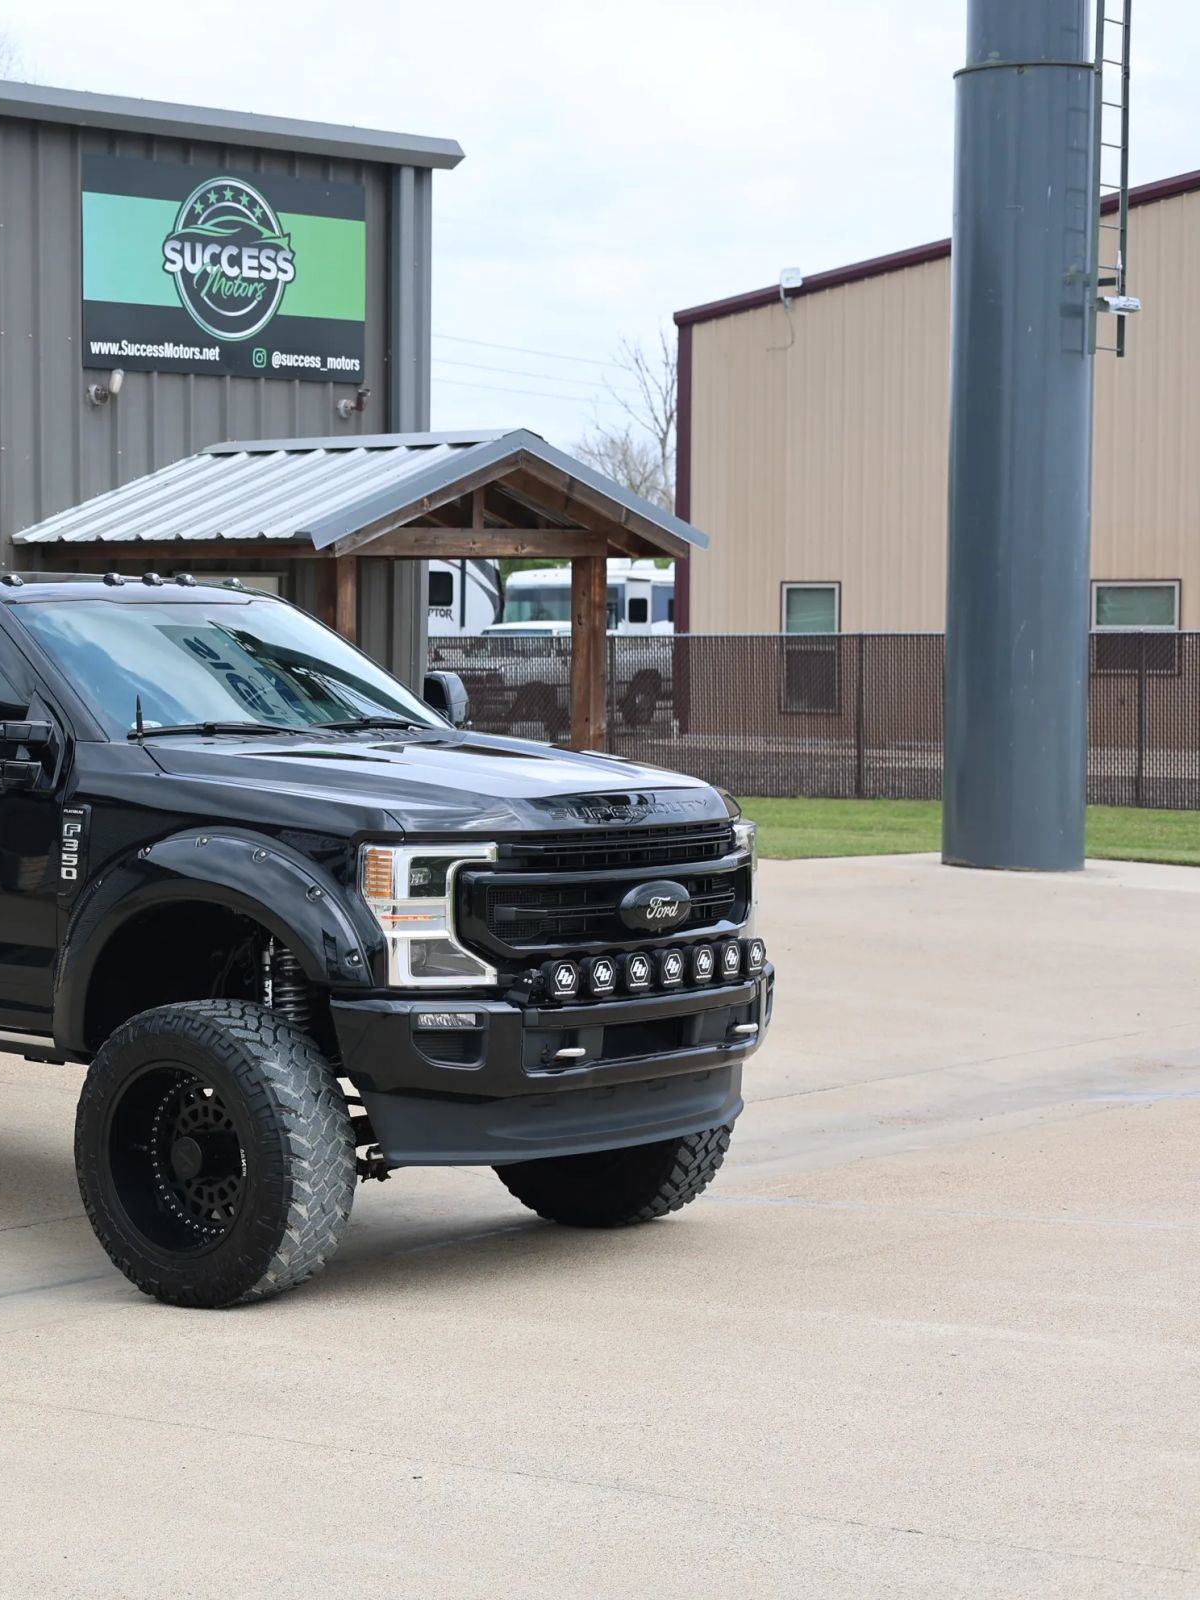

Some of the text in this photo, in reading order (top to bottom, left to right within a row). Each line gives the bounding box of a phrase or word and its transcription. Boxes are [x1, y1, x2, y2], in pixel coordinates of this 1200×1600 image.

[164, 240, 295, 281] SUCCESS
[193, 261, 267, 301] Motors
[90, 340, 220, 361] www.SuccessMotors.net
[271, 350, 360, 371] @success_motors
[61, 823, 81, 880] F350
[646, 896, 679, 919] Ford
